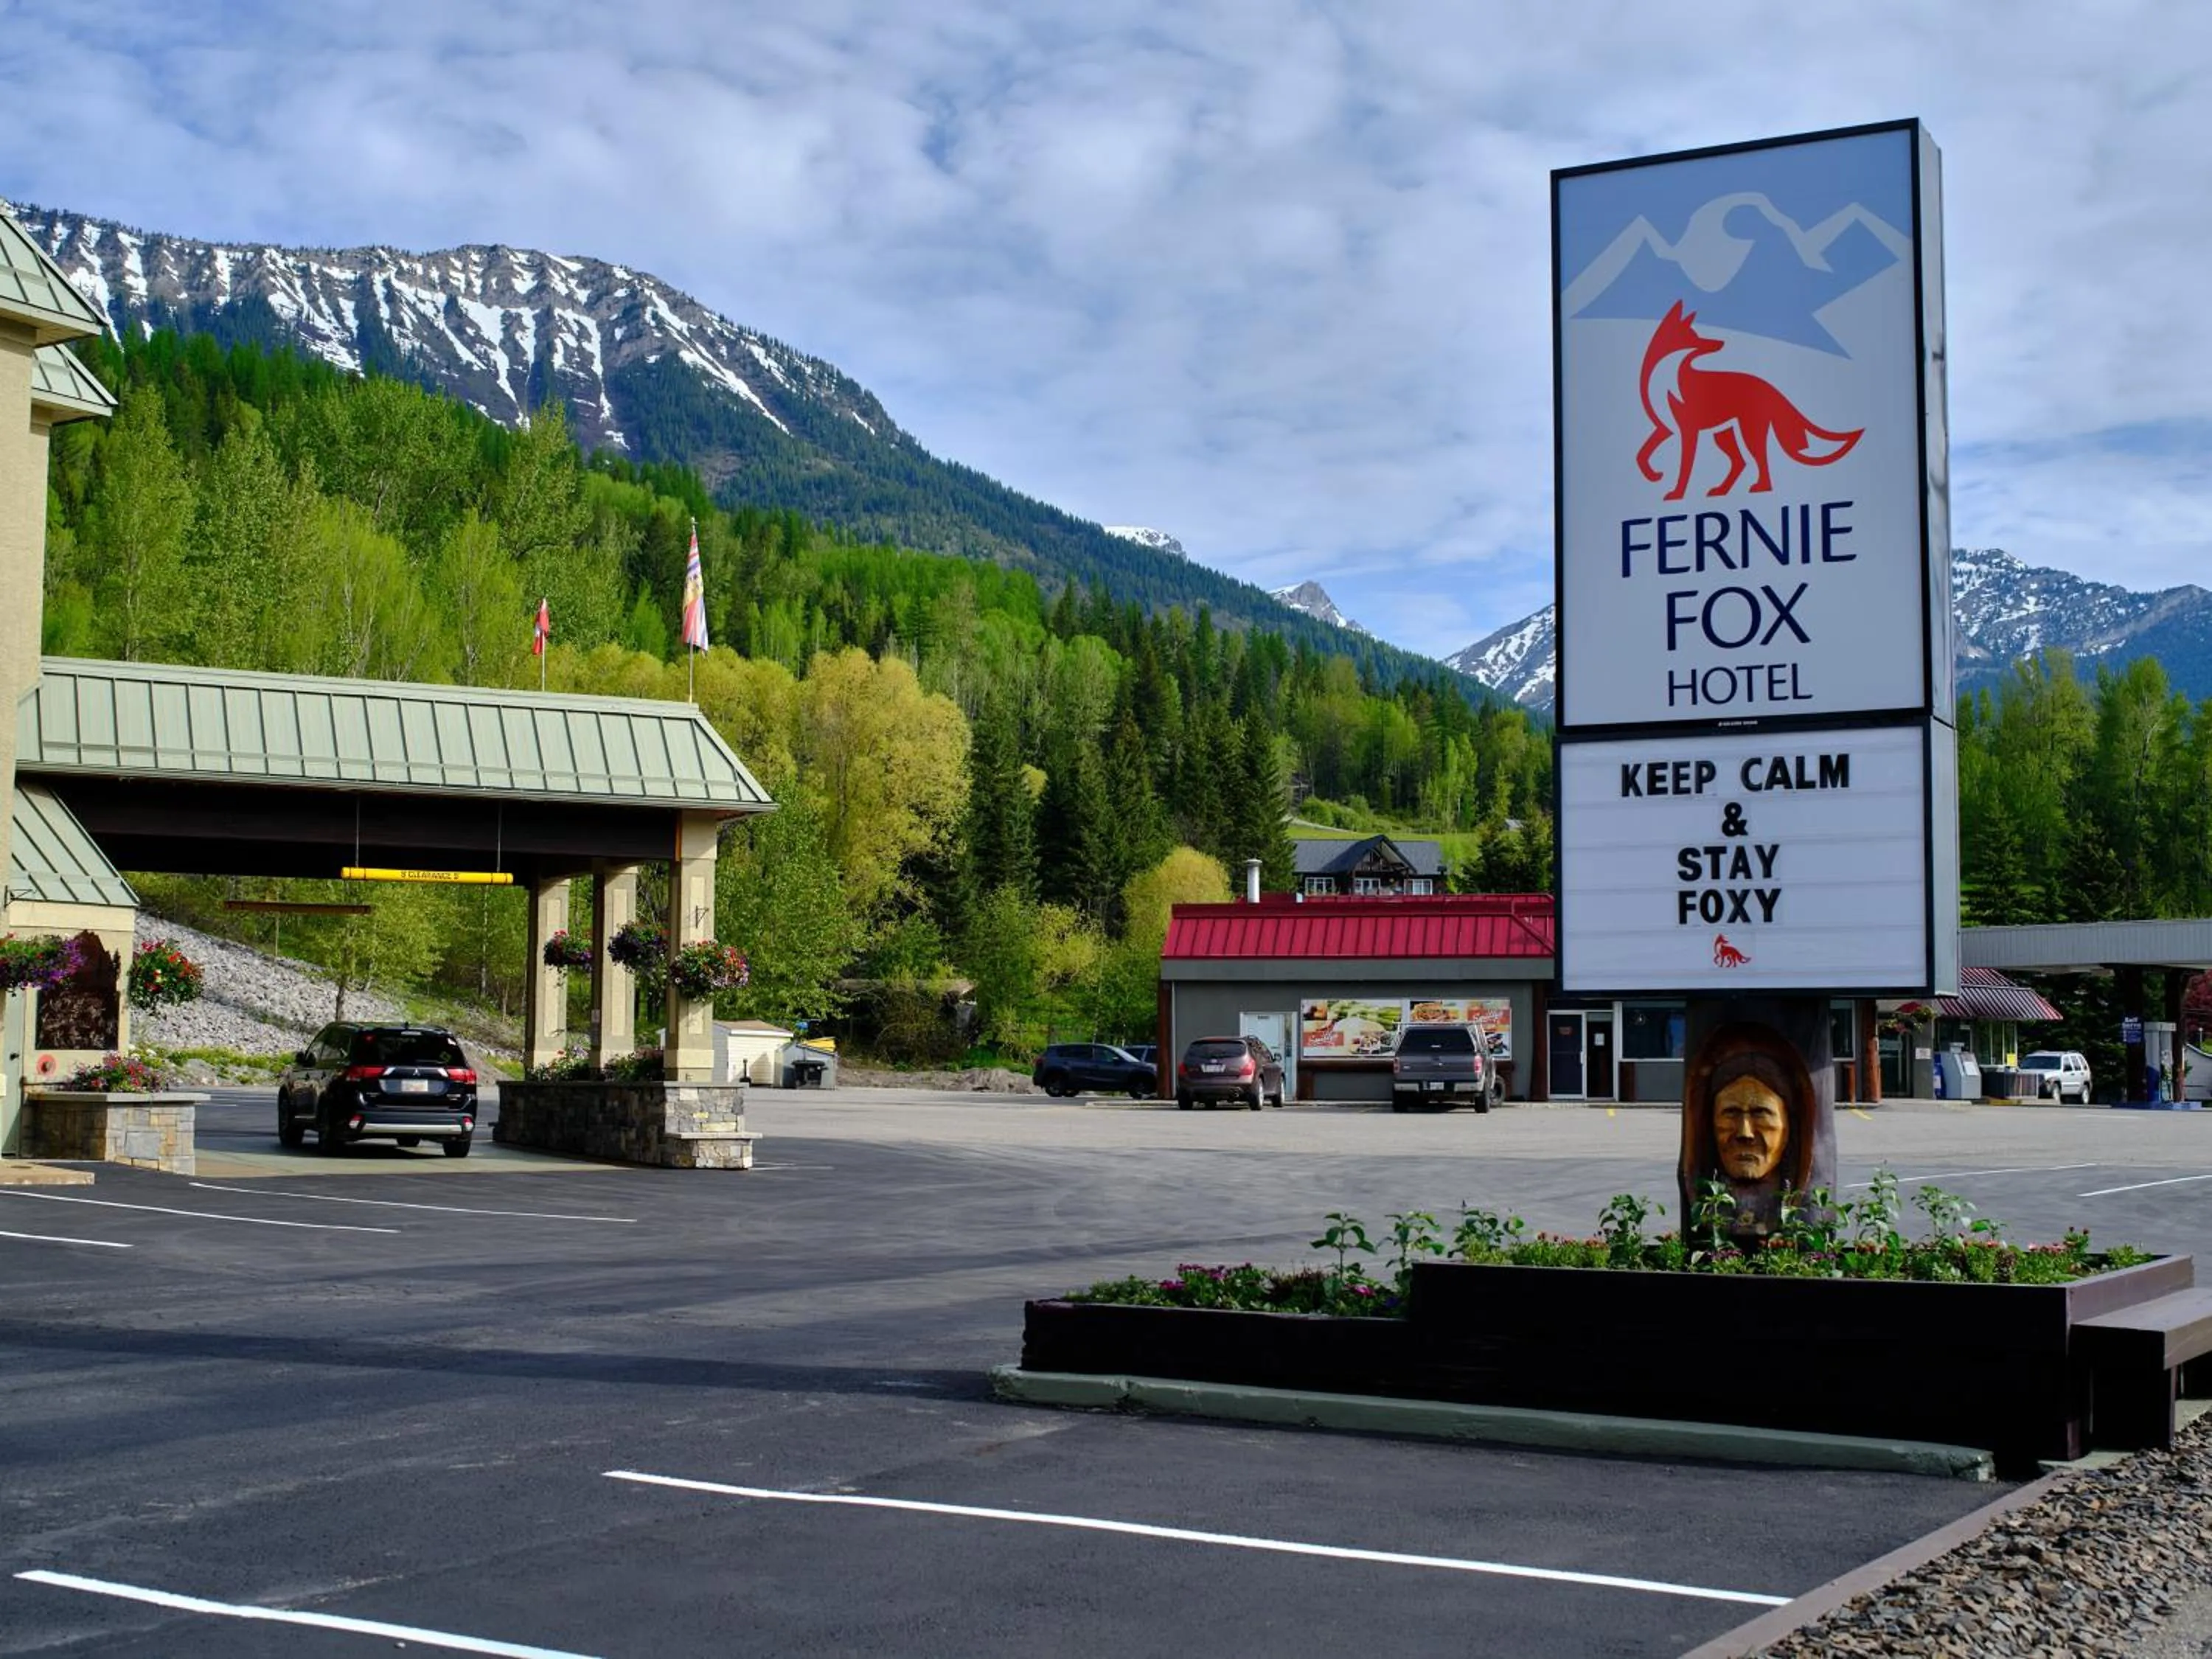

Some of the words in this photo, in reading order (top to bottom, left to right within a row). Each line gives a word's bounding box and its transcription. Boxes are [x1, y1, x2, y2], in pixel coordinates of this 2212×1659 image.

[1621, 501, 1857, 578] FERNIE
[1666, 582, 1812, 651] FOX
[1668, 663, 1813, 706] HOTEL
[1621, 760, 1717, 797] KEEP
[1740, 753, 1850, 793] CALM
[1721, 801, 1749, 838] &
[1677, 844, 1780, 882] STAY
[1677, 888, 1782, 925] FOXY
